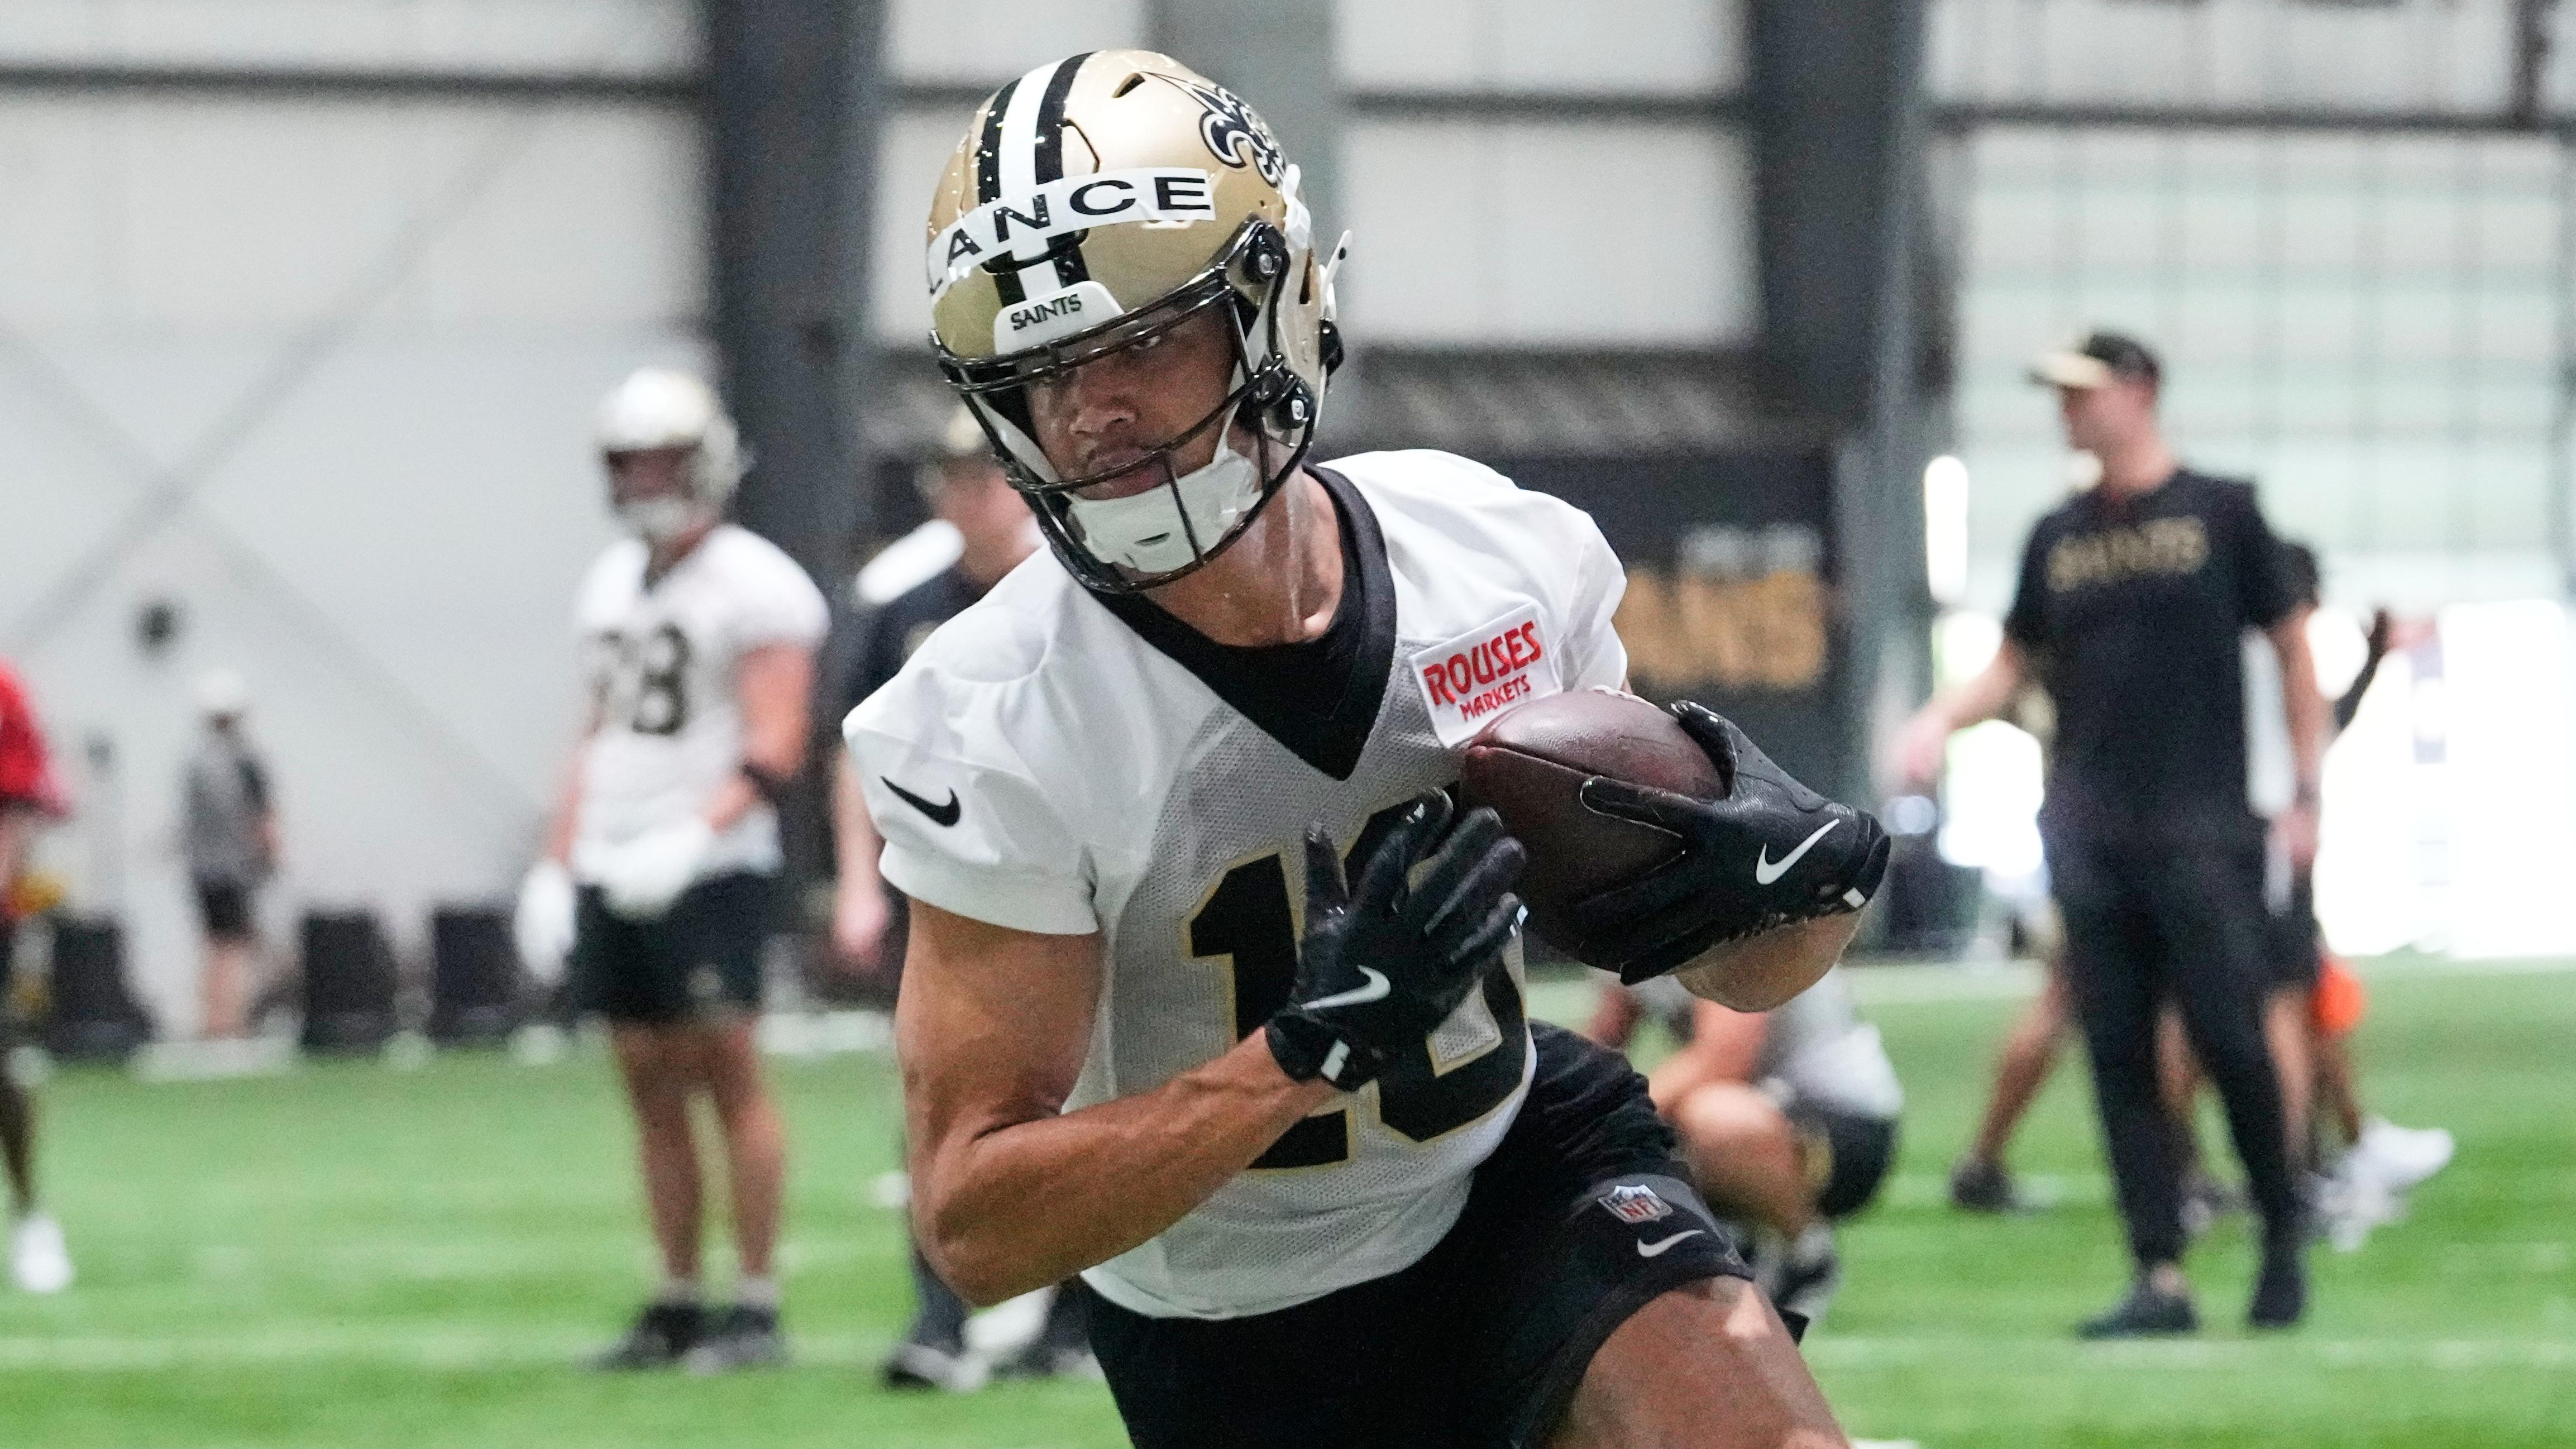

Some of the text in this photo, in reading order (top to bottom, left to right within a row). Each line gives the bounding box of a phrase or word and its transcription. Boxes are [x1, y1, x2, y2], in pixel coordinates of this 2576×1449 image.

[1011, 293, 1082, 331] SAINTS
[1423, 620, 1542, 706] ROUSES
[1460, 674, 1531, 722] MARKETS
